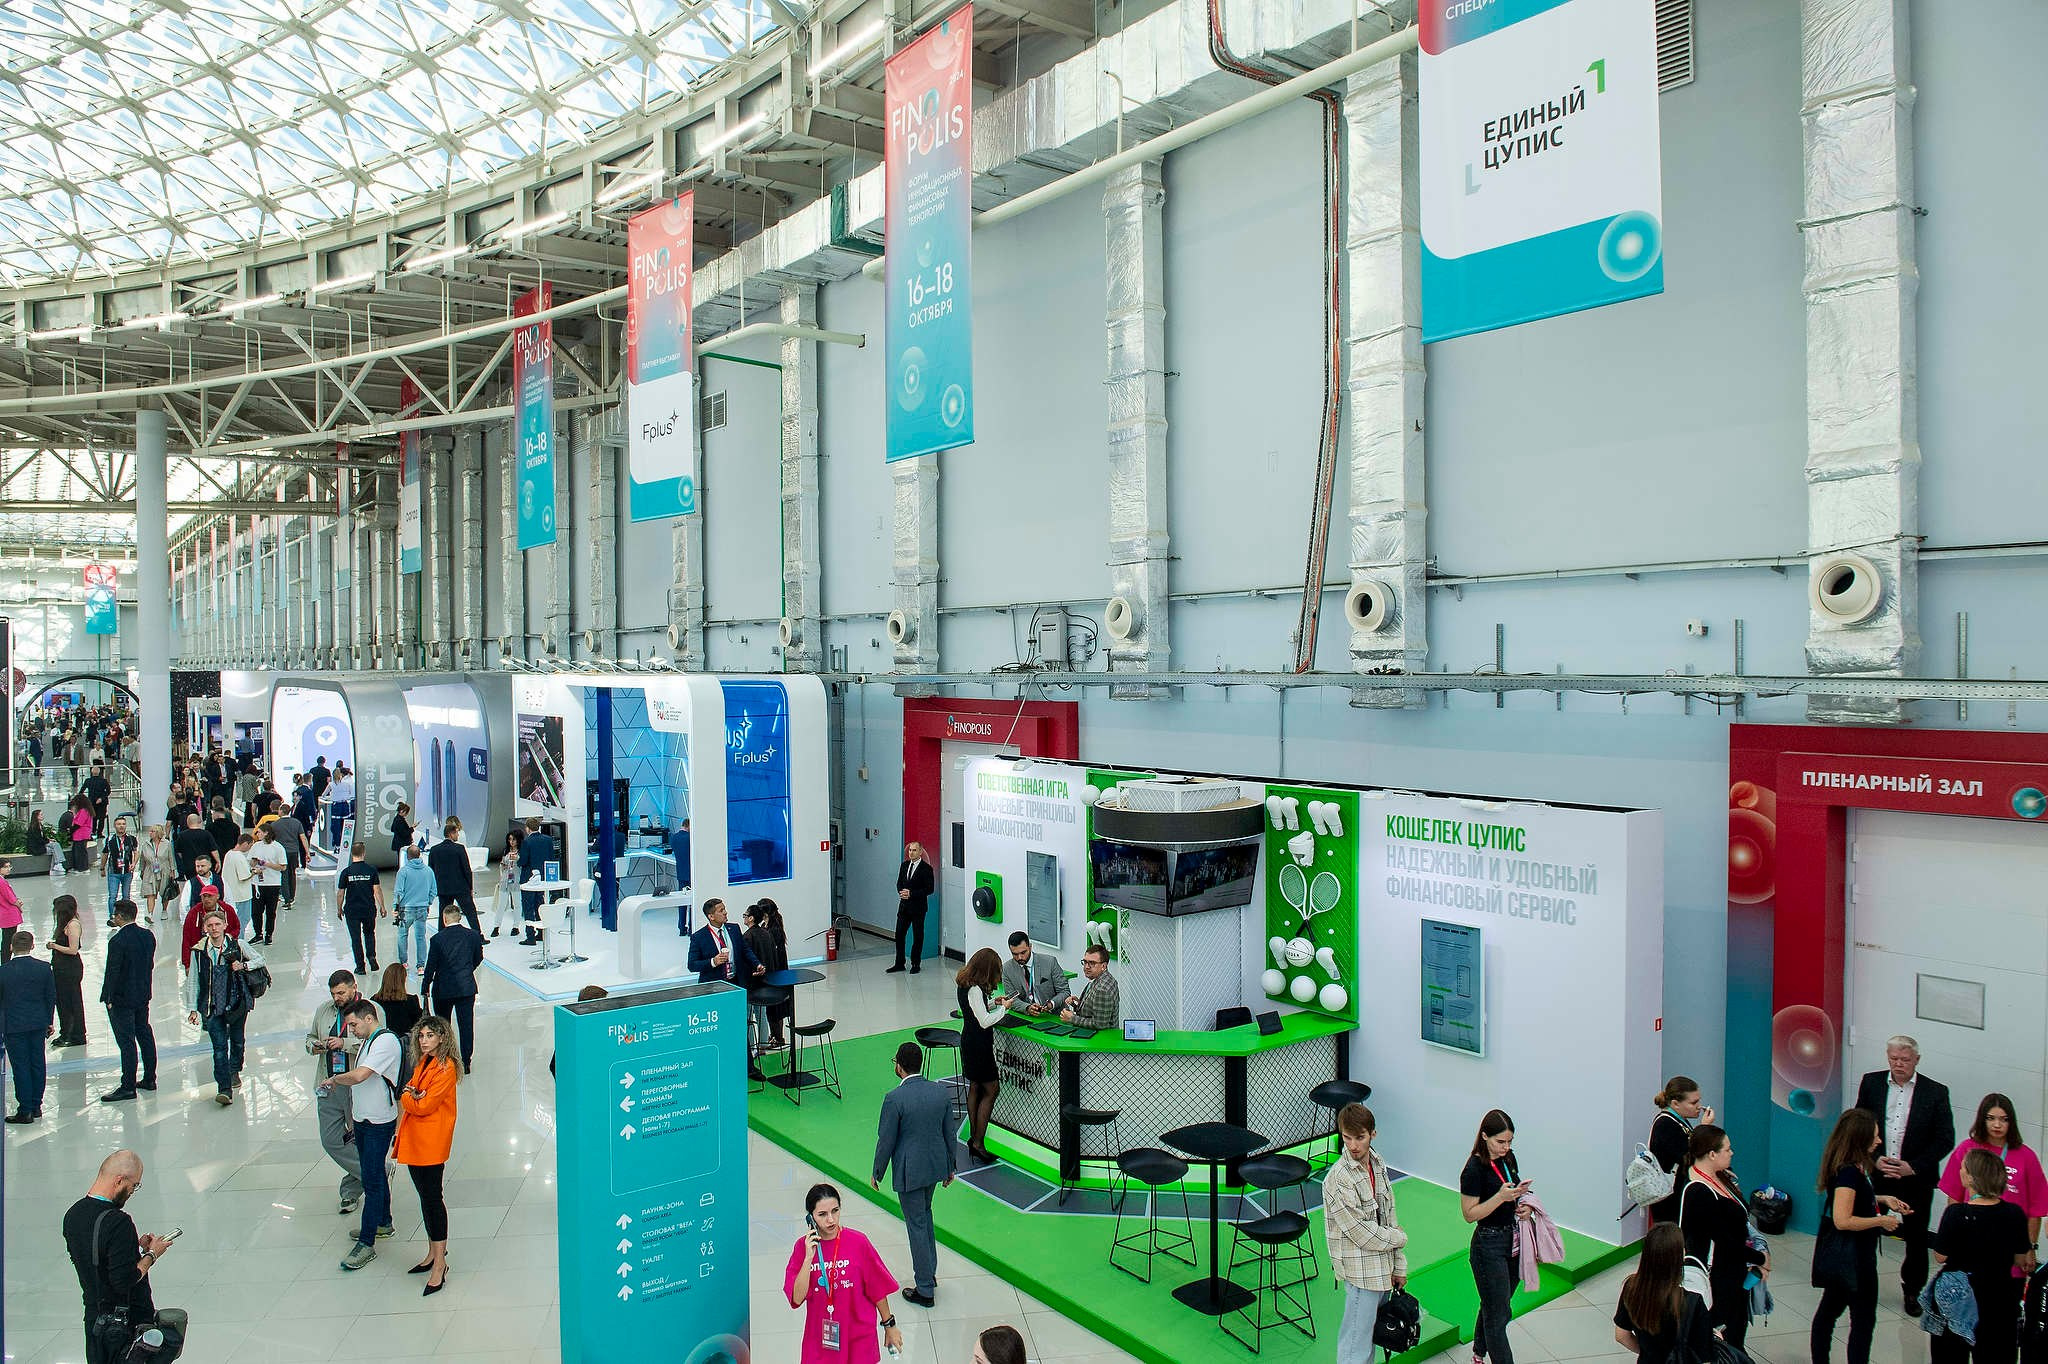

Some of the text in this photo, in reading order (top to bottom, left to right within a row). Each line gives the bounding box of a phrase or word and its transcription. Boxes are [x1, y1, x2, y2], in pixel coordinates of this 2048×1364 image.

[1484, 85, 1585, 143] ЕДИНЫЙ
[1484, 125, 1563, 170] ЦУПИС
[908, 298, 953, 328] ОКТЯБРЯ
[954, 721, 992, 735] FINOPOLIS
[734, 752, 769, 766] Fplus
[977, 772, 1069, 799] ОТВЕТСТВЕННАЯ ИГРА
[1802, 771, 1983, 797] ПЛЕНАРНЫЙ ЗАЛ
[363, 783, 379, 838] капсула
[977, 793, 1076, 824] КЛЮЧЕВЫЕ ПРИНЦИПЫ
[977, 815, 1043, 841] САМОКОНТРОЛЯ
[1386, 814, 1526, 852] КОШЕЛЕК ЦУПИС
[1386, 844, 1599, 896] НАДЕЖНЫЙ И УДОБНЫЙ
[1386, 874, 1577, 926] ФИНАНСОВЫЙ СЕРВИС
[617, 1030, 649, 1046] POLIS
[688, 1024, 718, 1036] ОКТЯБРЯ
[641, 1060, 694, 1076] ПЛЕНАРНЫЙ ЗАЛ
[641, 1081, 689, 1096] ПЕРЕГОВОРНЫЕ
[641, 1093, 673, 1105] КОМНАТЫ
[641, 1104, 711, 1125] ДЕЛОВАЯ ПРОГРАММА
[641, 1200, 685, 1216] ЛАУНЖ-ЗОНА
[641, 1225, 675, 1239] СТОЛОВАЯ
[641, 1254, 664, 1265] ТУАЛЕТ
[641, 1277, 665, 1289] ВЫХОД
